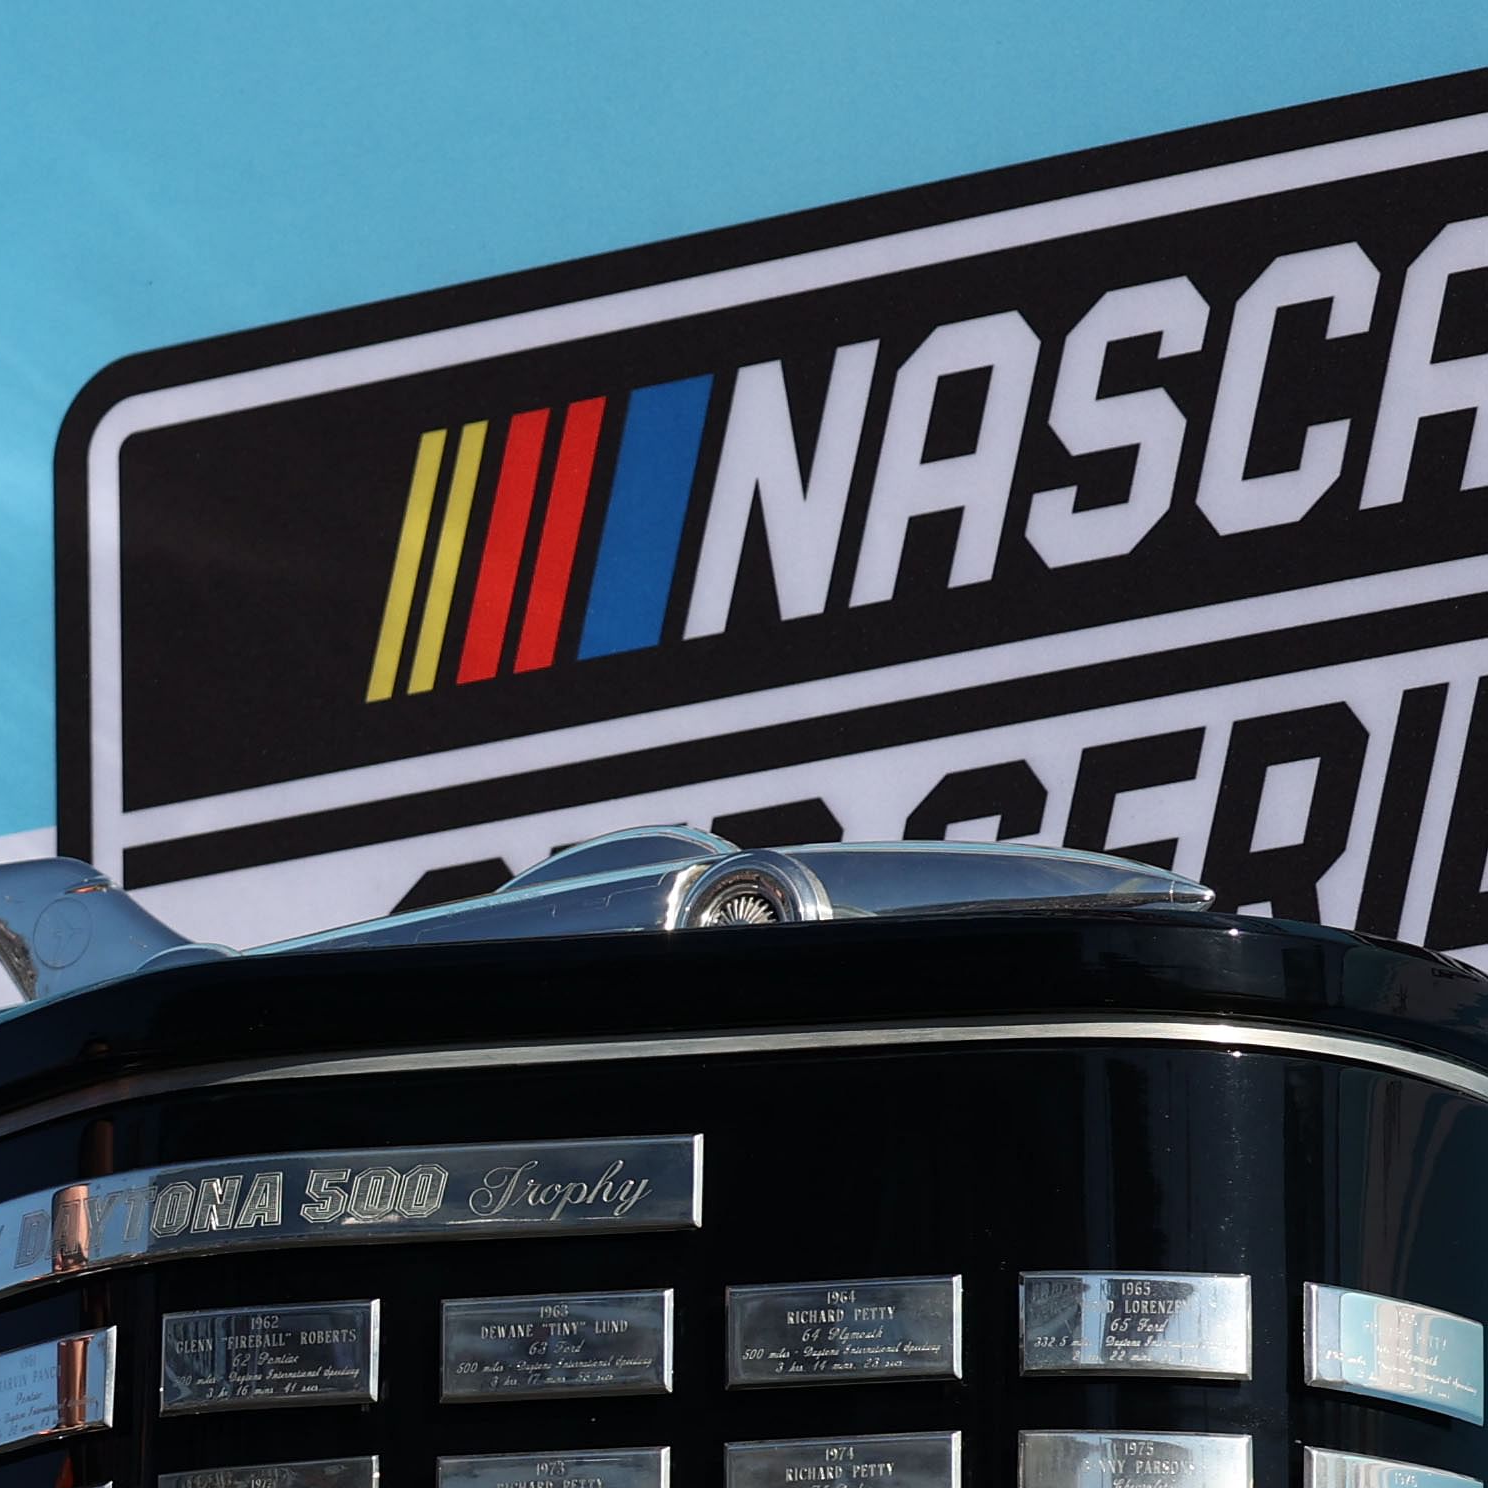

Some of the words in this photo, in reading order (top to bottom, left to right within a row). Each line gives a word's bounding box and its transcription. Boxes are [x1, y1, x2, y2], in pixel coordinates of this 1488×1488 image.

[13, 1171, 285, 1270] DAYTONA
[299, 1163, 449, 1224] 500
[468, 1159, 652, 1221] Trophy
[1121, 1282, 1151, 1296] 1965
[827, 1290, 856, 1304] 1964
[540, 1304, 569, 1318] 1963
[787, 1310, 844, 1324] RICHARD
[854, 1307, 897, 1320] PETTY
[250, 1315, 280, 1330] 1962
[481, 1325, 533, 1339] DEWANE
[595, 1320, 628, 1334] LUND
[1111, 1319, 1128, 1332] 65
[176, 1338, 213, 1354] GLENN
[300, 1328, 357, 1345] ROBERTS
[825, 1448, 855, 1461] 1974
[1125, 1442, 1154, 1455] 1975
[536, 1461, 565, 1475] 1973
[785, 1466, 843, 1482] RICHARD
[852, 1463, 895, 1477] PETTY
